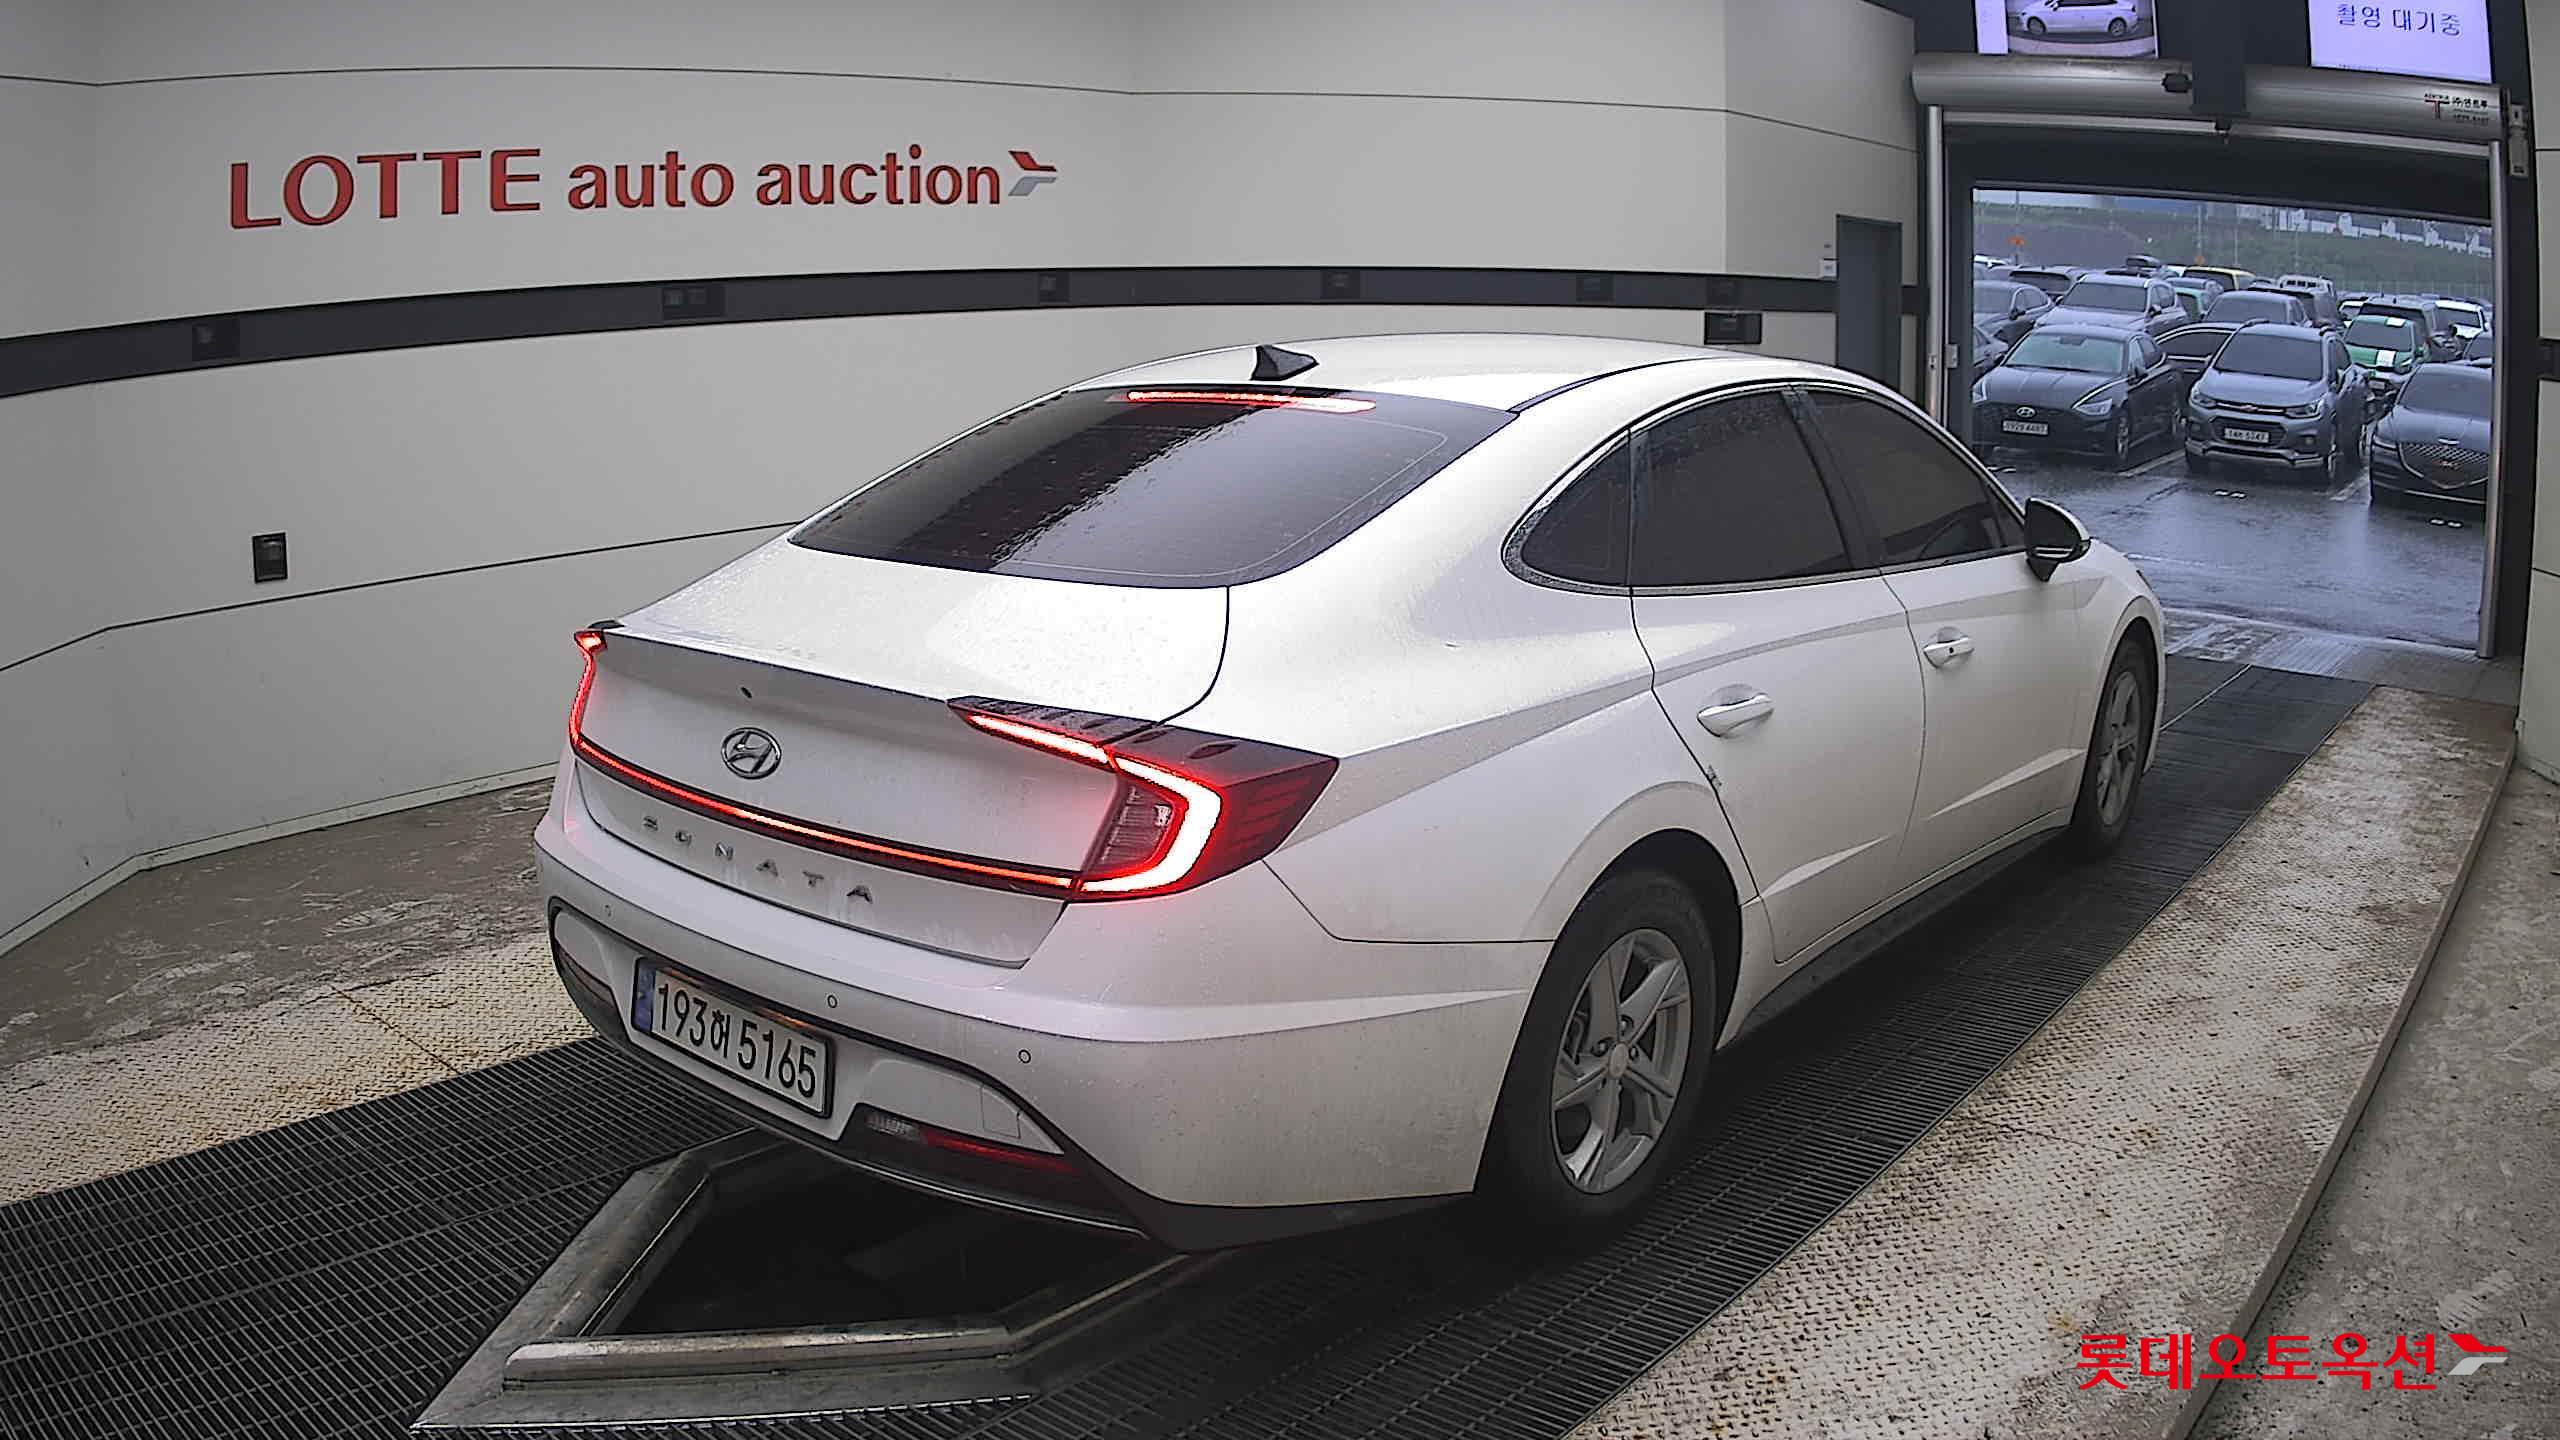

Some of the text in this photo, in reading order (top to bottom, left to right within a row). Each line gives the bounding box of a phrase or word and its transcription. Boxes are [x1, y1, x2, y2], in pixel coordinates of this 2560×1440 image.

[2337, 3, 2461, 36] 촬영 대기중
[229, 143, 1002, 230] LOTTE auto auction
[642, 815, 873, 905] SONATA
[658, 983, 817, 1099] 193허 5165
